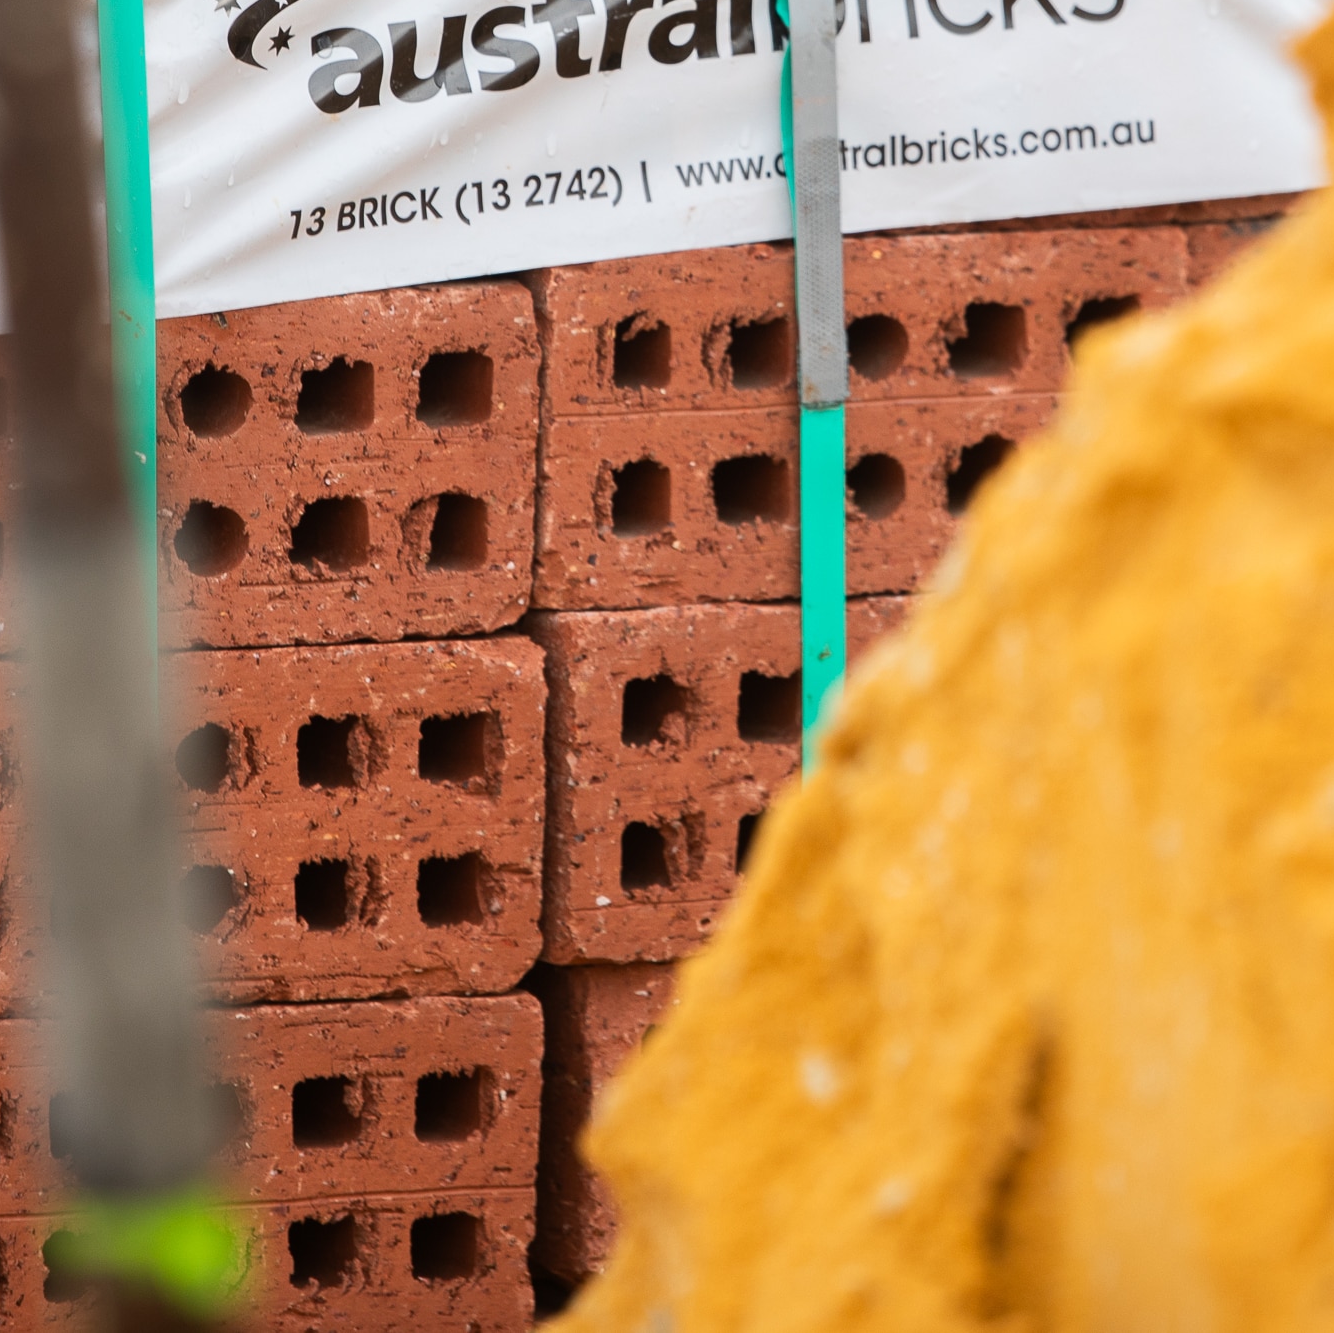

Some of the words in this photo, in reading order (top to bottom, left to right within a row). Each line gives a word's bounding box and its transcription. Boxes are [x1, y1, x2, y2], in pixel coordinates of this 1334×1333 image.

[289, 206, 327, 241] 13
[335, 185, 444, 234] BRICK
[454, 176, 513, 227] (13
[523, 164, 624, 209] 2742)
